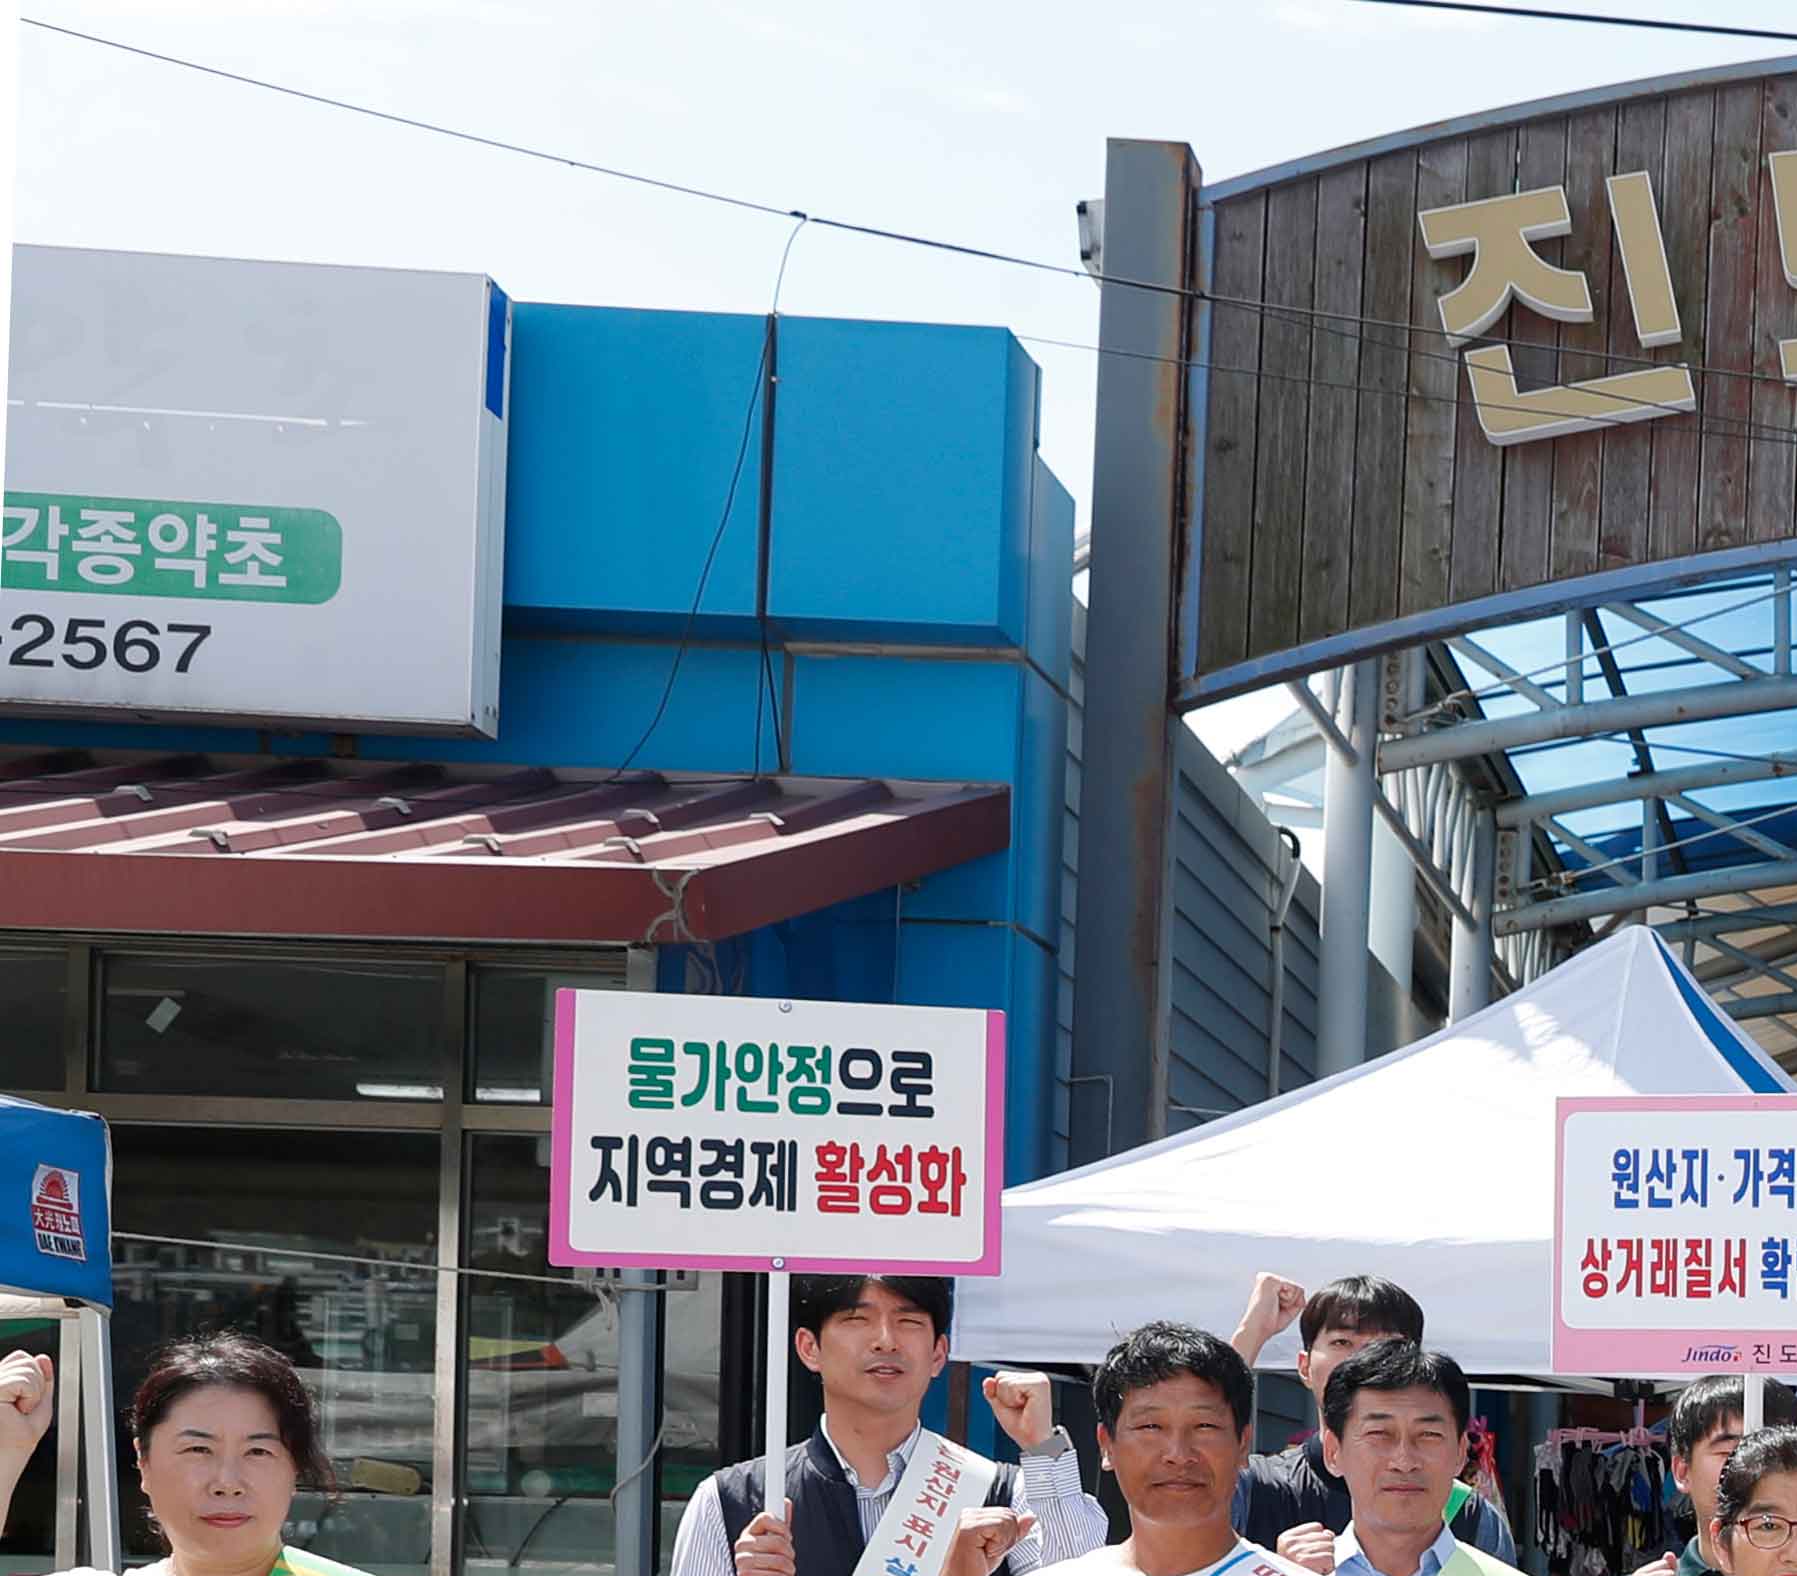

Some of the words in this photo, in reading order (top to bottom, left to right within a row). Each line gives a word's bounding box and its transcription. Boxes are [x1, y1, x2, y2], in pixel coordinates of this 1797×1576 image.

[0, 503, 290, 590] 각종약초
[626, 1036, 936, 1118] 물가안정으로
[588, 1134, 798, 1213] 지역경제
[812, 1142, 968, 1217] 활성화
[1580, 1236, 1748, 1300] 상거래질서
[1681, 1346, 1733, 1364] Jindo
